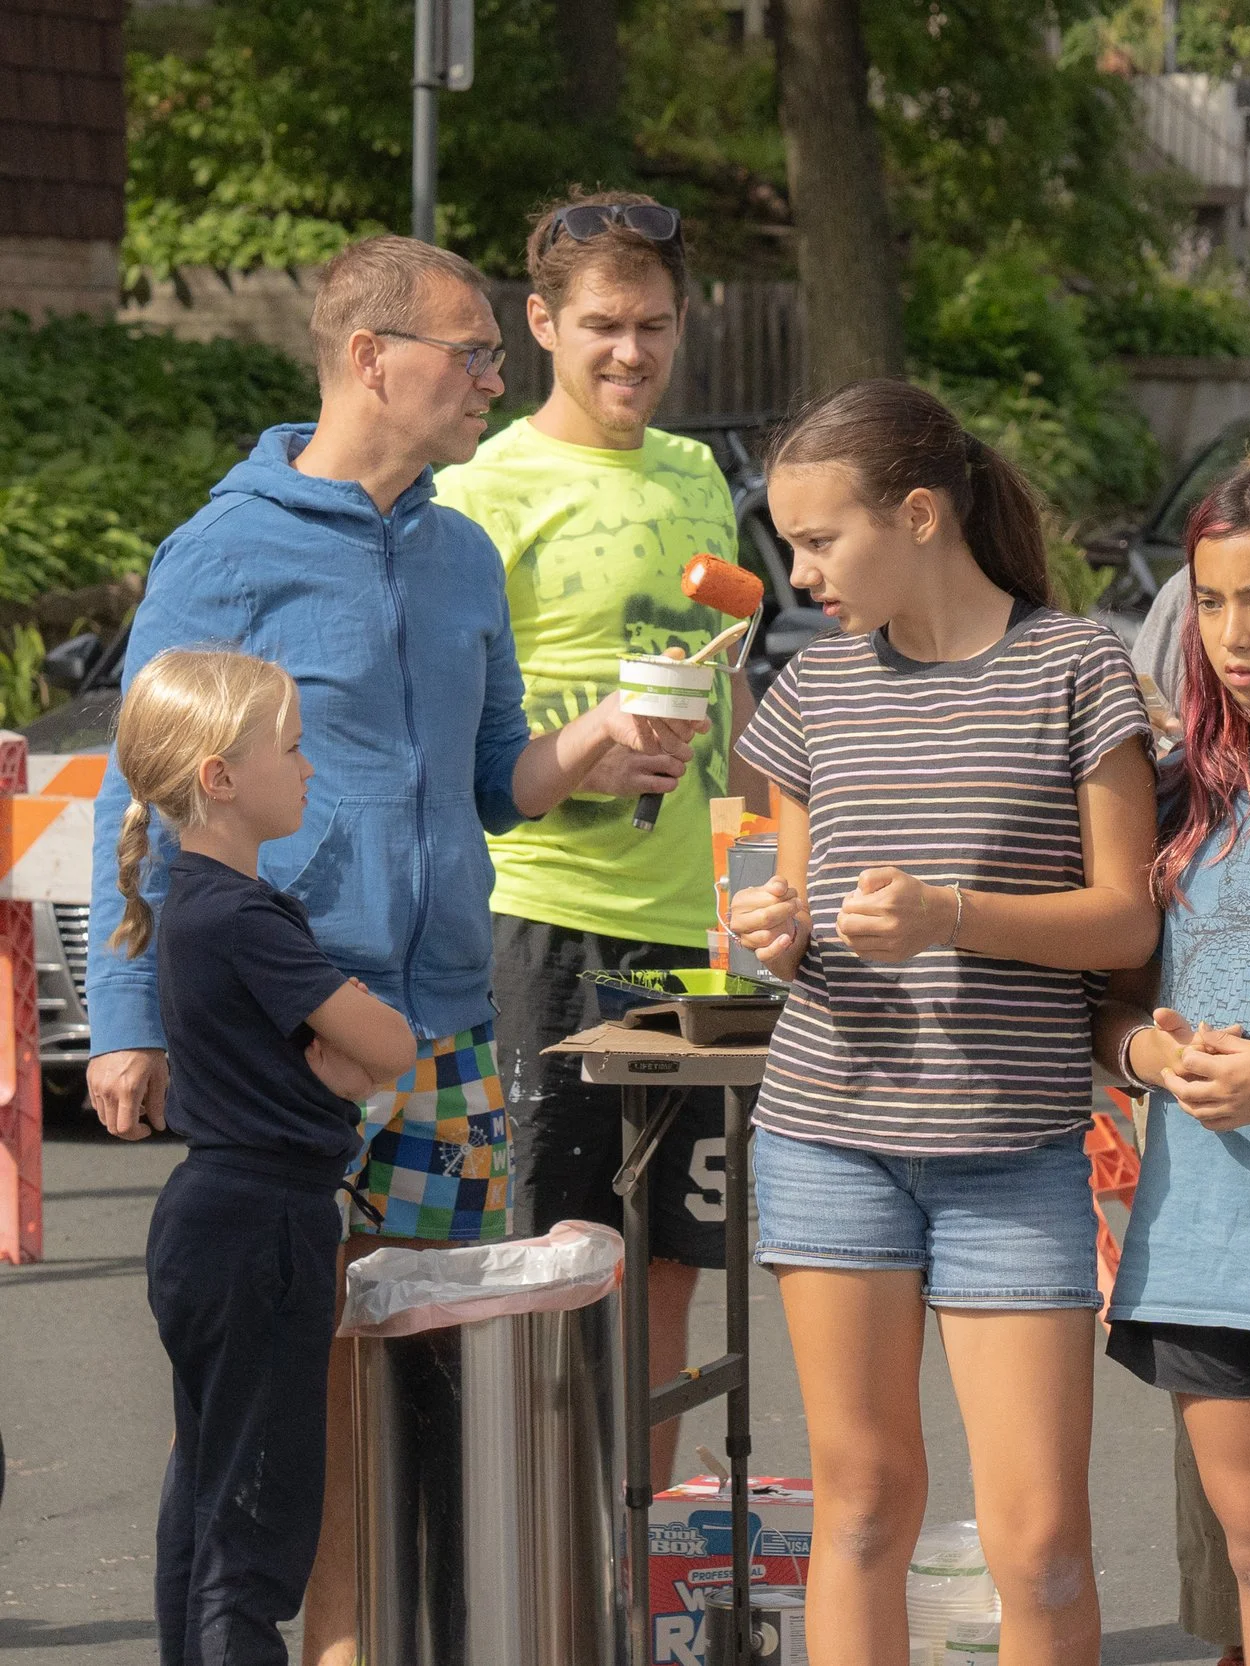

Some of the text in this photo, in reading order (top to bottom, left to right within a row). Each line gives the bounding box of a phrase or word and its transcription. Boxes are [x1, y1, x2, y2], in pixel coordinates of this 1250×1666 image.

[651, 1540, 707, 1556] BOX
[788, 1541, 810, 1552] USA
[691, 1567, 764, 1581] PROFESAL
